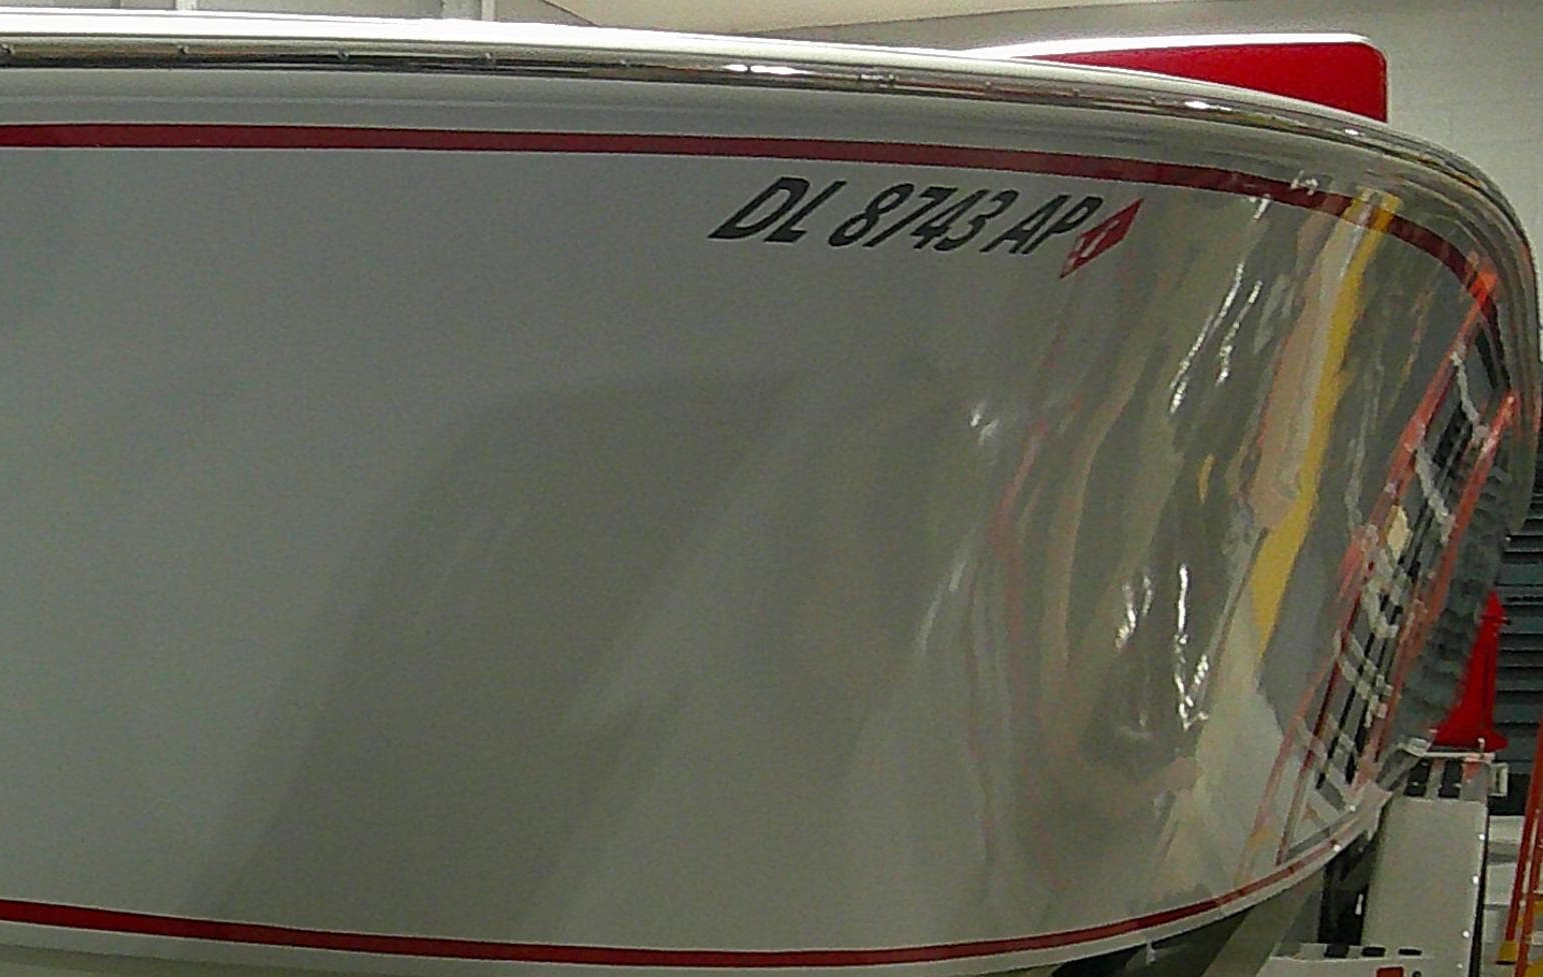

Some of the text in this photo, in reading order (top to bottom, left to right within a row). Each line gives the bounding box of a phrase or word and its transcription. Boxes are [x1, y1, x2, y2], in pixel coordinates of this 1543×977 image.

[708, 176, 846, 243] DL
[828, 182, 1019, 251] 8743
[979, 193, 1103, 255] AP
